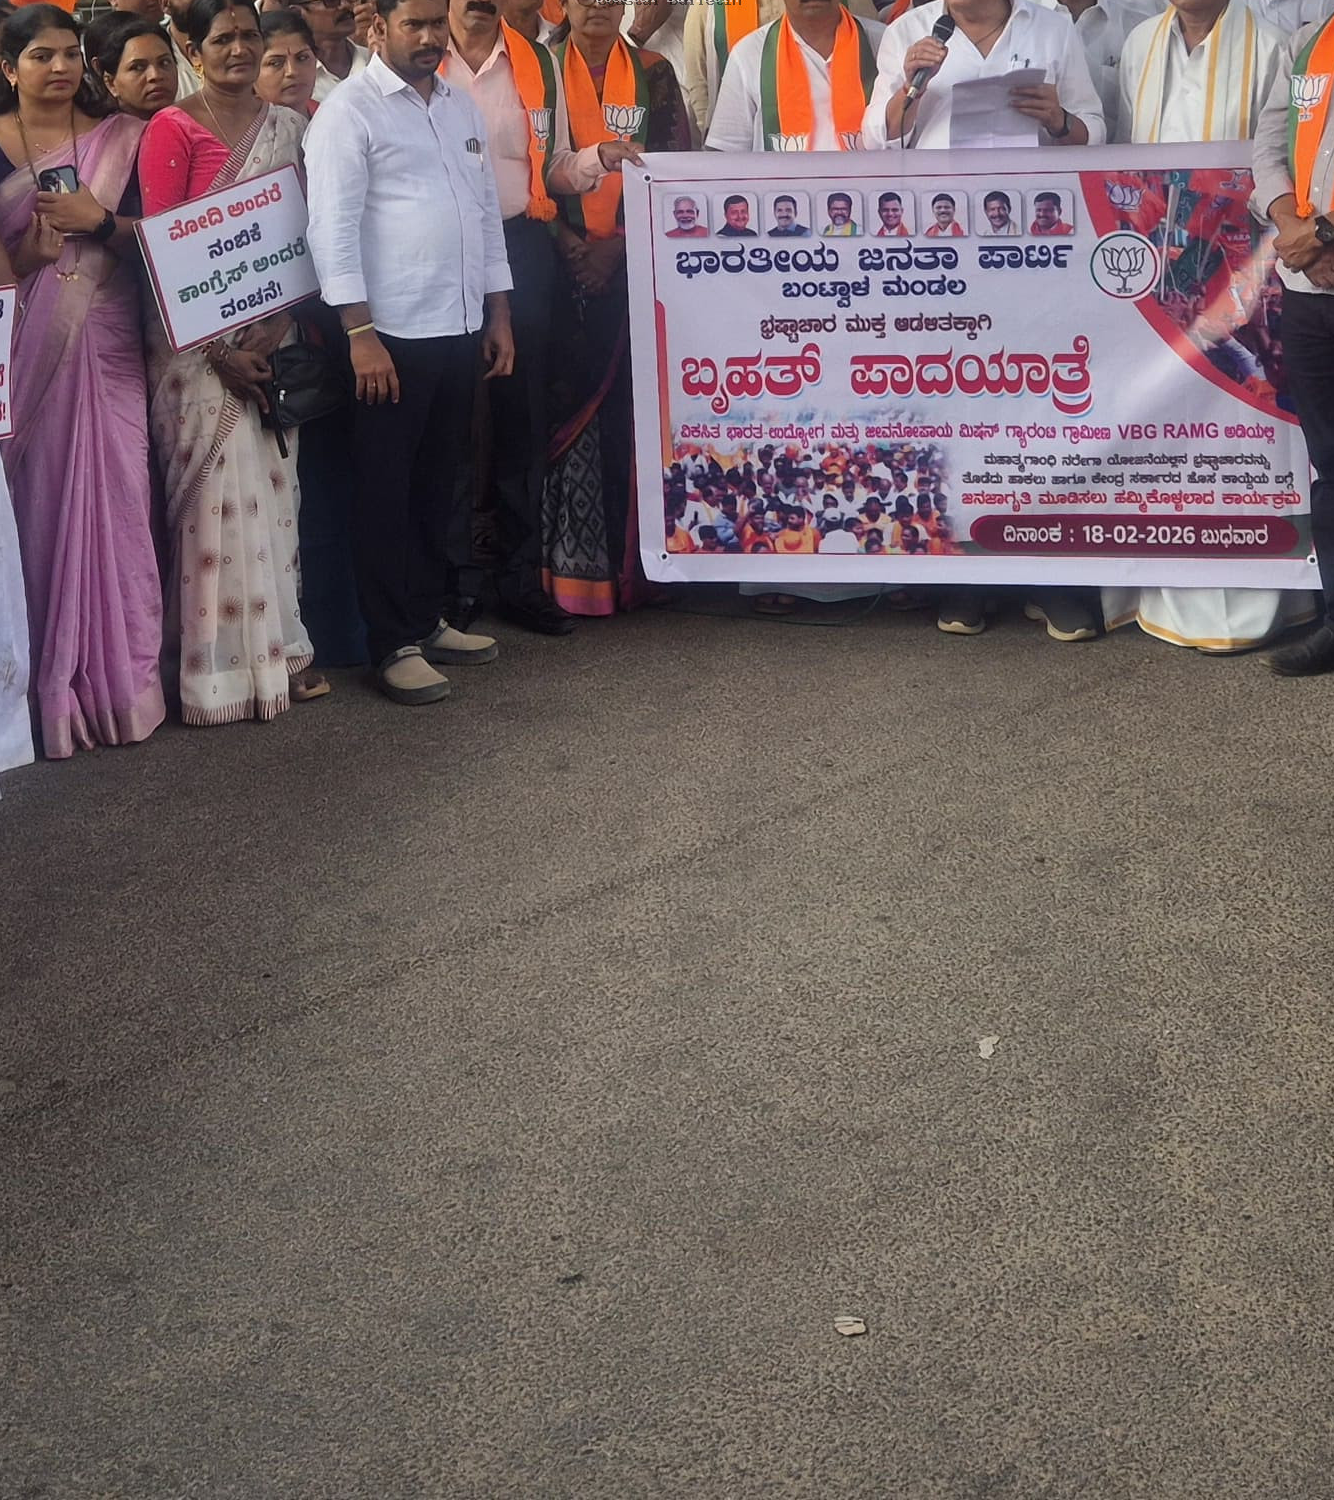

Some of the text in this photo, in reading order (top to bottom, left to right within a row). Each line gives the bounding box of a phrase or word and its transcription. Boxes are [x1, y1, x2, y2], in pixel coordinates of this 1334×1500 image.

[168, 182, 282, 241] ಮೋದಿ ಅಂದರೆ
[208, 222, 262, 259] ನಂಬಿಕೆ
[178, 237, 306, 304] ಕಾಂಗ್ರೆಸ್ ಅಂದರೆ
[676, 240, 1073, 279] ಭಾರತೀಯ ಜನತಾ ಪಾರ್ಟಿ
[220, 280, 283, 319] ವಂಚನೆ!
[781, 274, 967, 308] ಬಂಟ್ವಾಳ ಮಂಡಲ
[760, 313, 992, 343] ಭ್ರಷ್ಟಾಚಾರ ಮುಕ್ತ ಆಡಳಿತಕ್ಕಾಗಿ
[680, 335, 1093, 418] ಬೃಹತ್ ಪಾದಯಾತ್ರೆ
[681, 422, 1219, 448] ವಿಕಸಿತ ಮತ್ತು ಜೀವನೋಪಾಯ ಮಿಷನ್ ಗ್ಯಾರಂಟಿ ಗ್ರಾಮೀಣ VBG RAMG
[1062, 453, 1102, 466] ನರೇಗಾ
[962, 471, 1217, 485] ತೊಡೆದು ಹಾಕಲು ಹಾಗೂ ಹೊಸ
[1038, 489, 1301, 512] ಮೂಡಿಸಲು ಹಮ್ಮಿಕೊಳ್ಳಲಾದ ಕಾರ್ಯಕ್ರಮ
[1003, 523, 1269, 546] ದಿನಾಂಕ 18-02-2026 ಬುಧವಾರ
